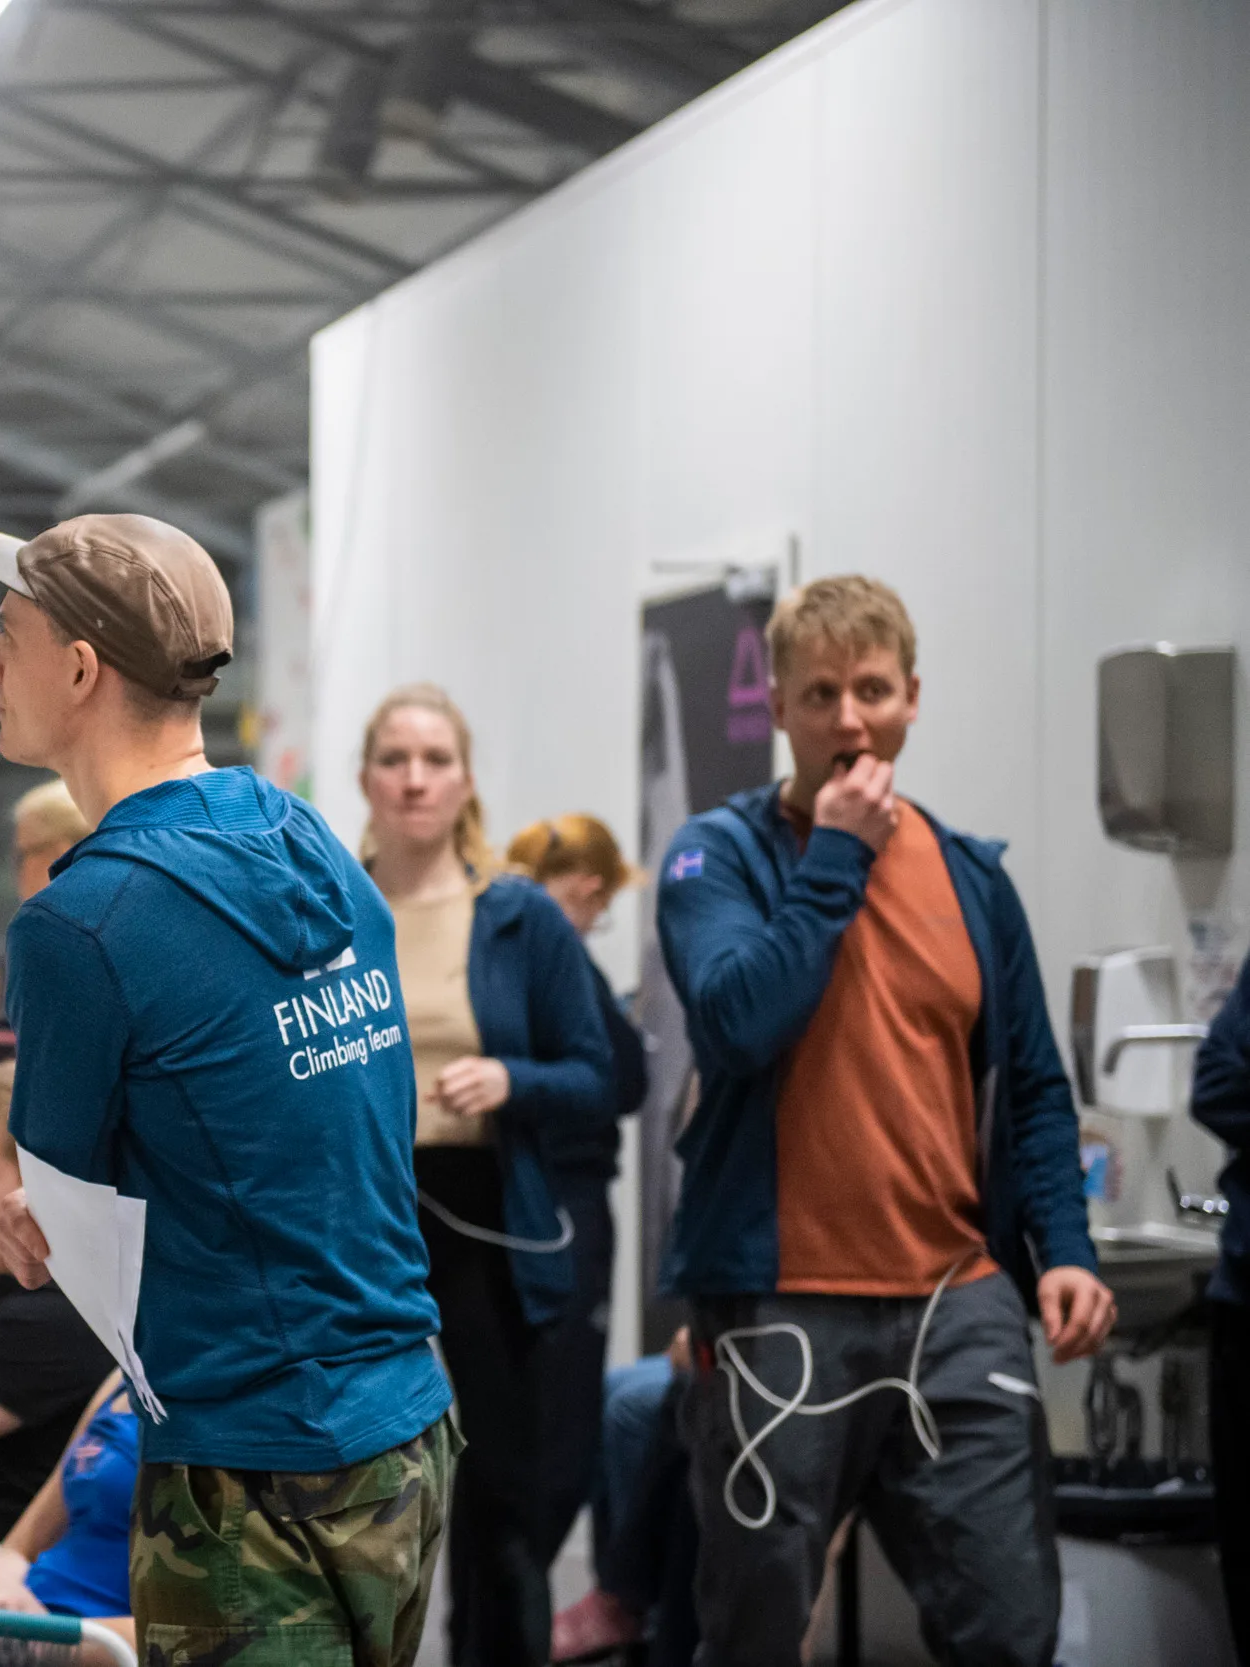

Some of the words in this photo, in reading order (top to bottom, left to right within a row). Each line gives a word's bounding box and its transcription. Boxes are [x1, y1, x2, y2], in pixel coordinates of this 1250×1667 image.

[273, 968, 392, 1046] FINLAND
[289, 1035, 369, 1081] Climbing
[364, 1023, 402, 1053] Team
